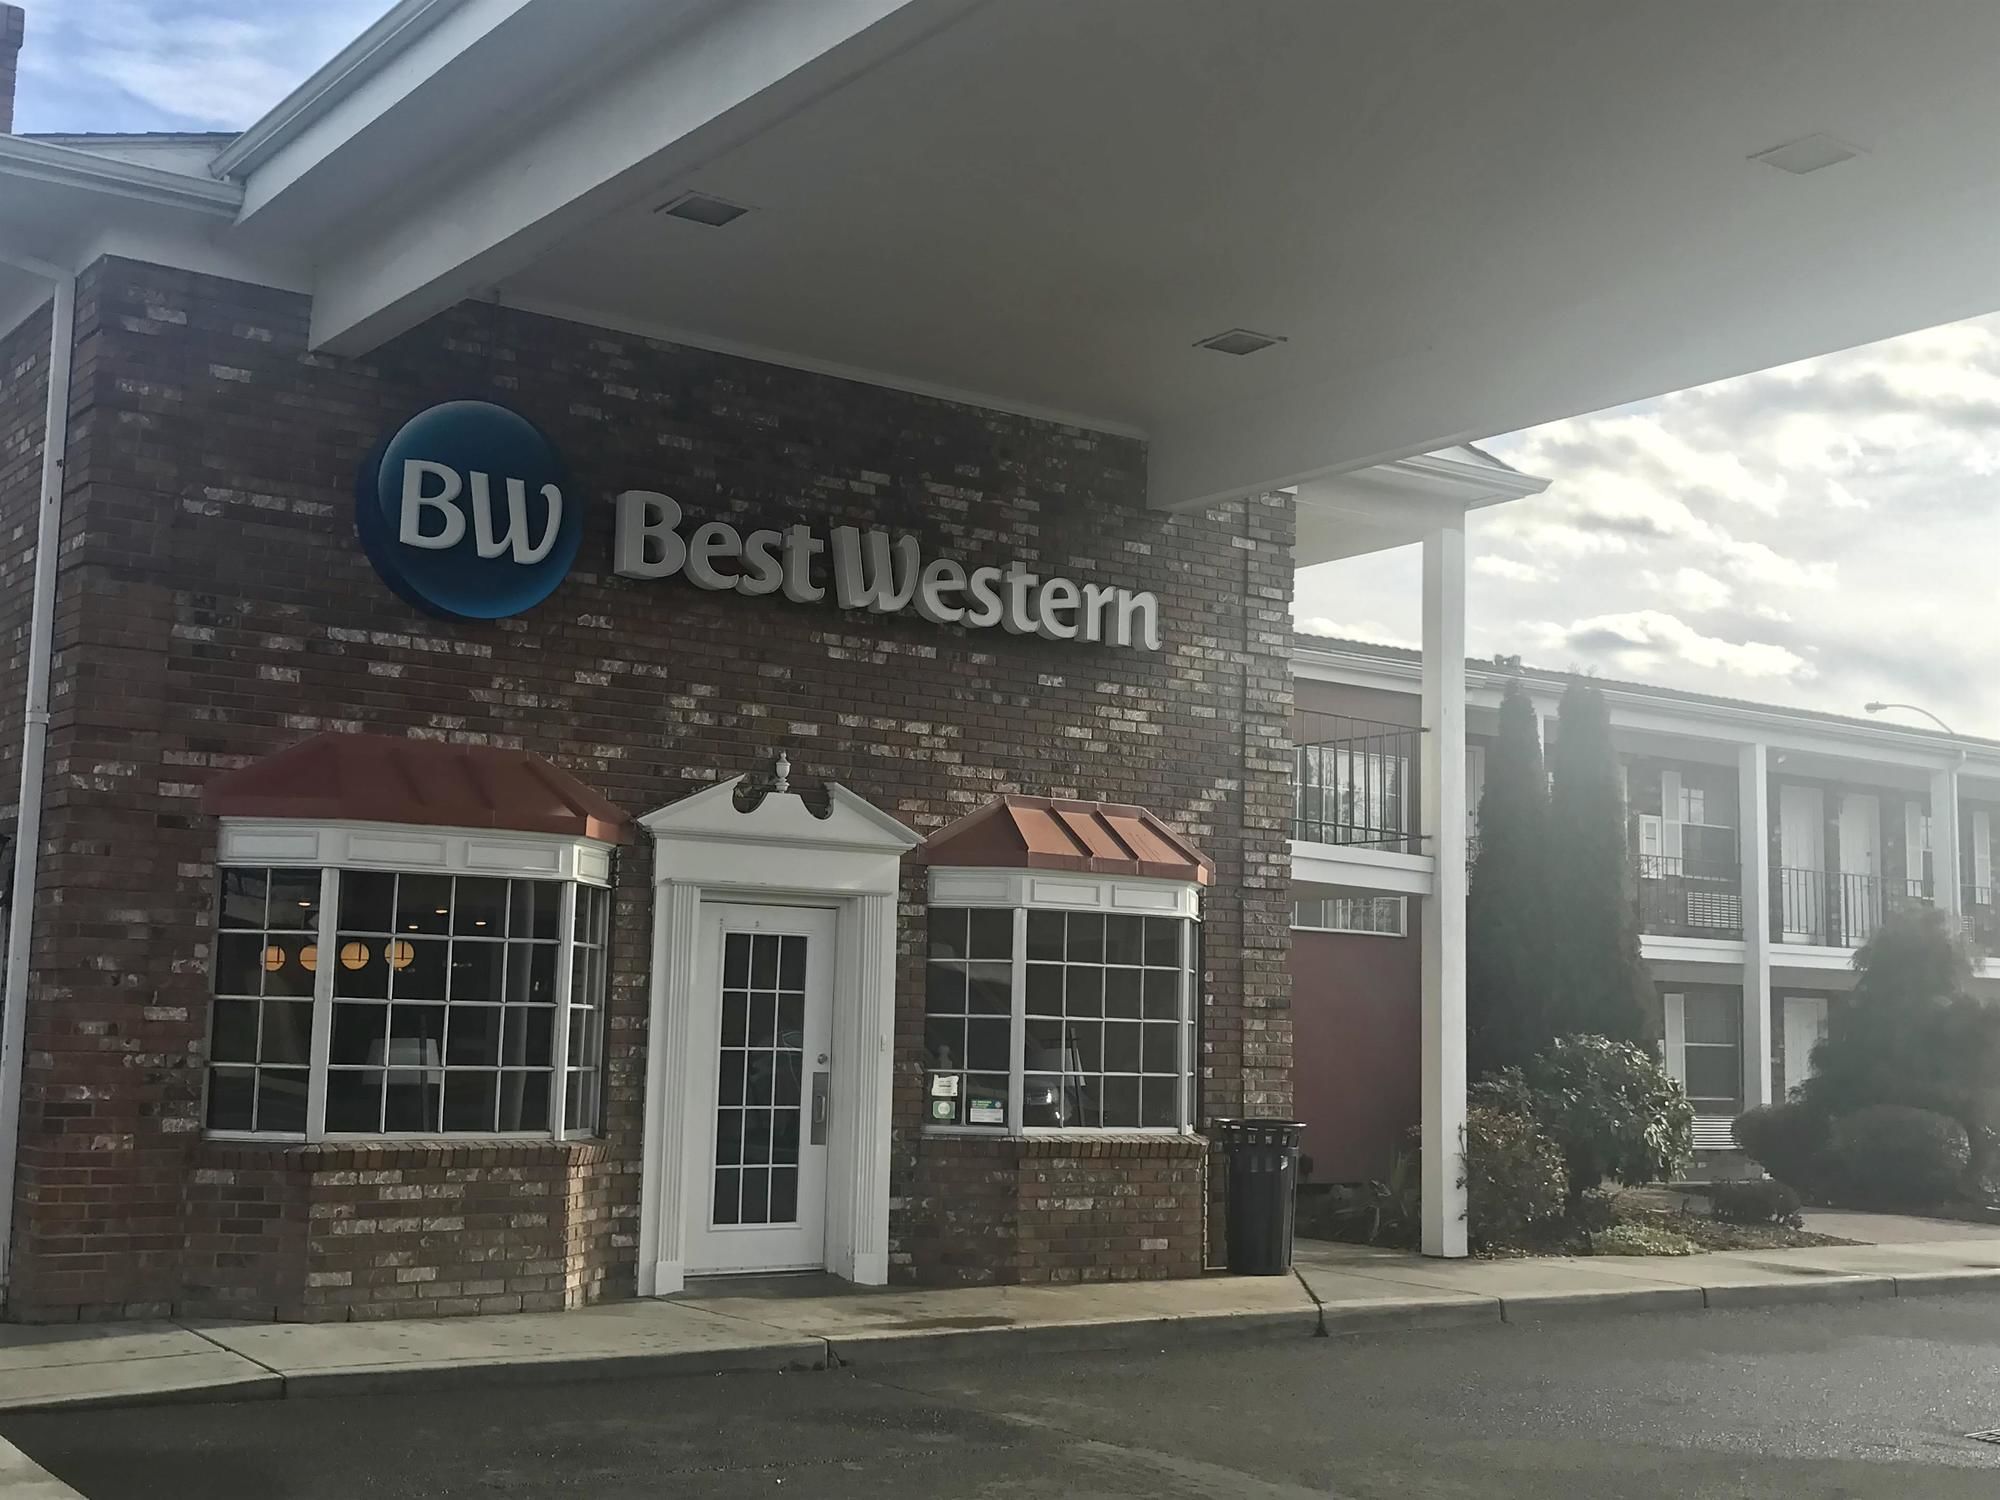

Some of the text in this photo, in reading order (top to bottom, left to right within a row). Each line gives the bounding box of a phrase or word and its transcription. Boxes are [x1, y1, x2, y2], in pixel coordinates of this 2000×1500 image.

[399, 458, 563, 566] BW
[613, 489, 1163, 651] Best Western
